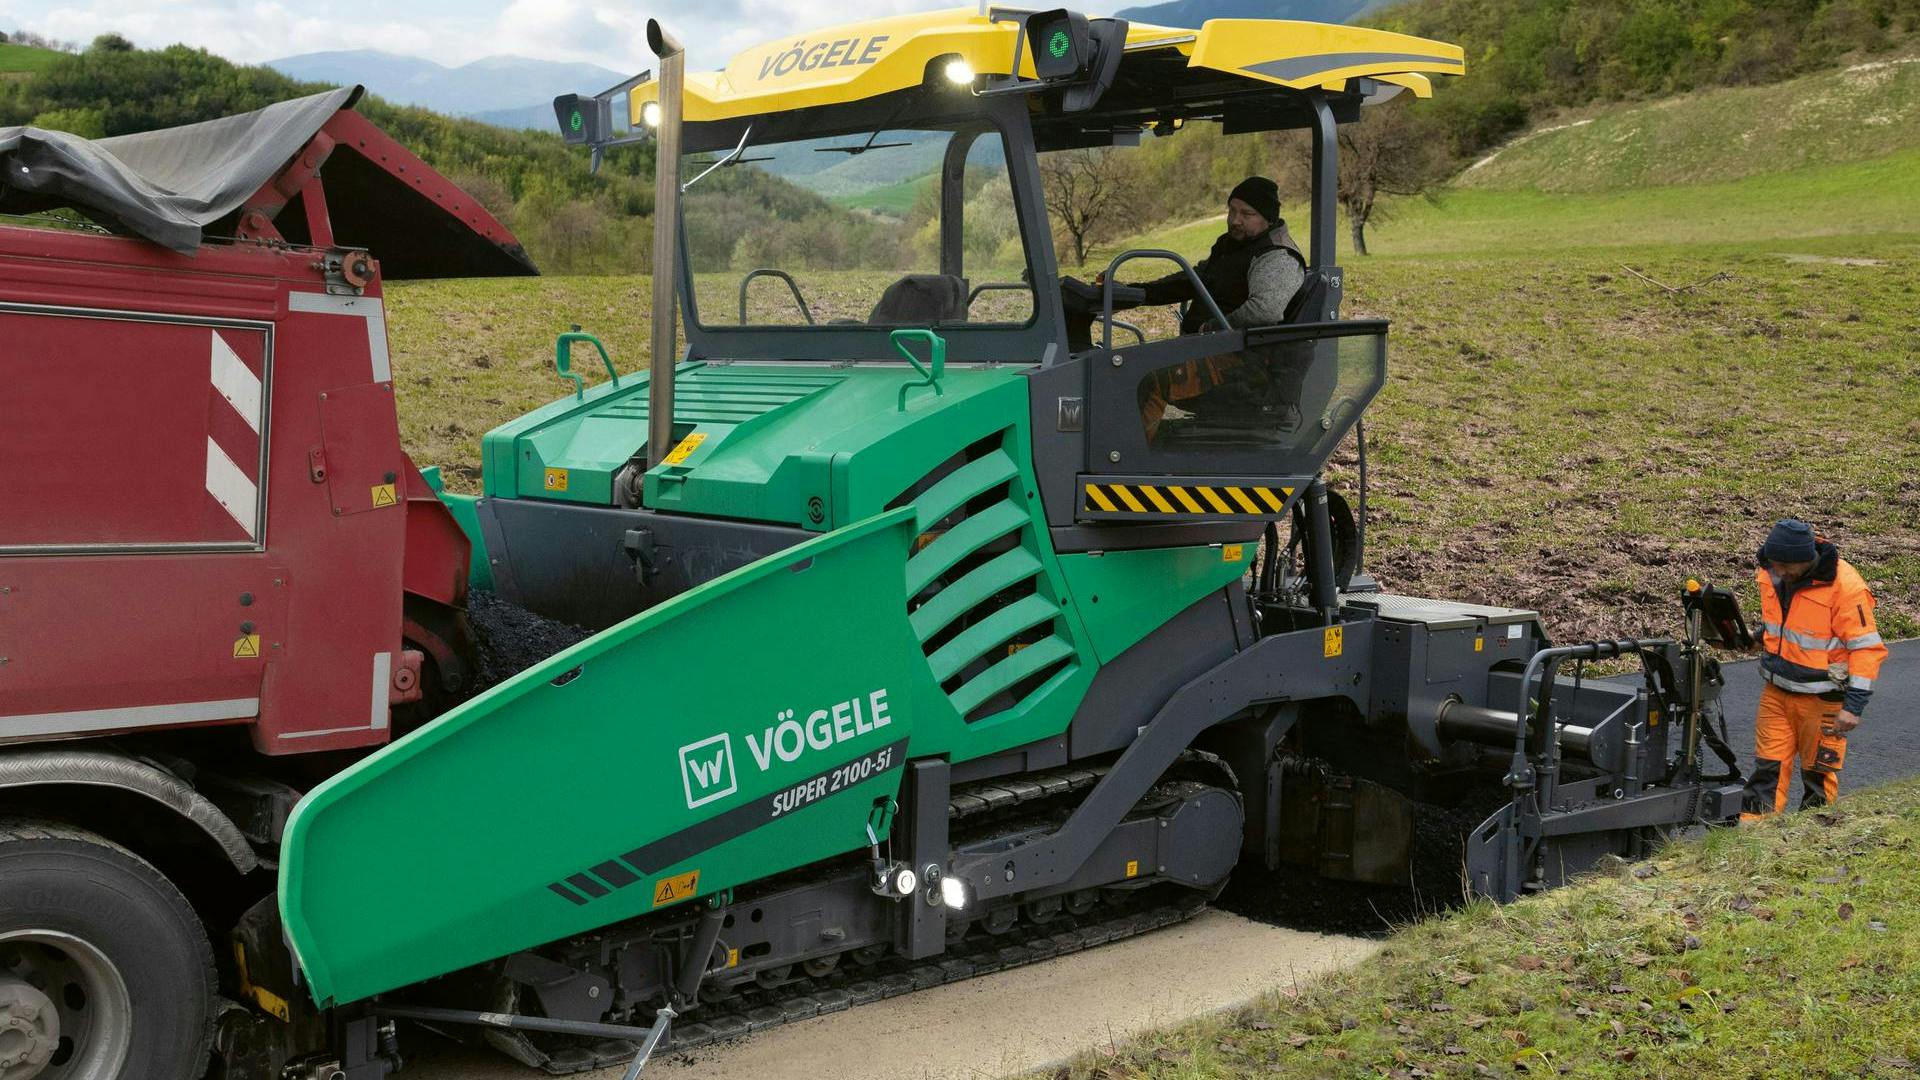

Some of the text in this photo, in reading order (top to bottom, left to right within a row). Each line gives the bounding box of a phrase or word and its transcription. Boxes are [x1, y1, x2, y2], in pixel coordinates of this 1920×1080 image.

[757, 35, 890, 81] VÖGELE
[745, 688, 892, 772] VÖGELE
[771, 747, 893, 817] SUPER 2100-5i
